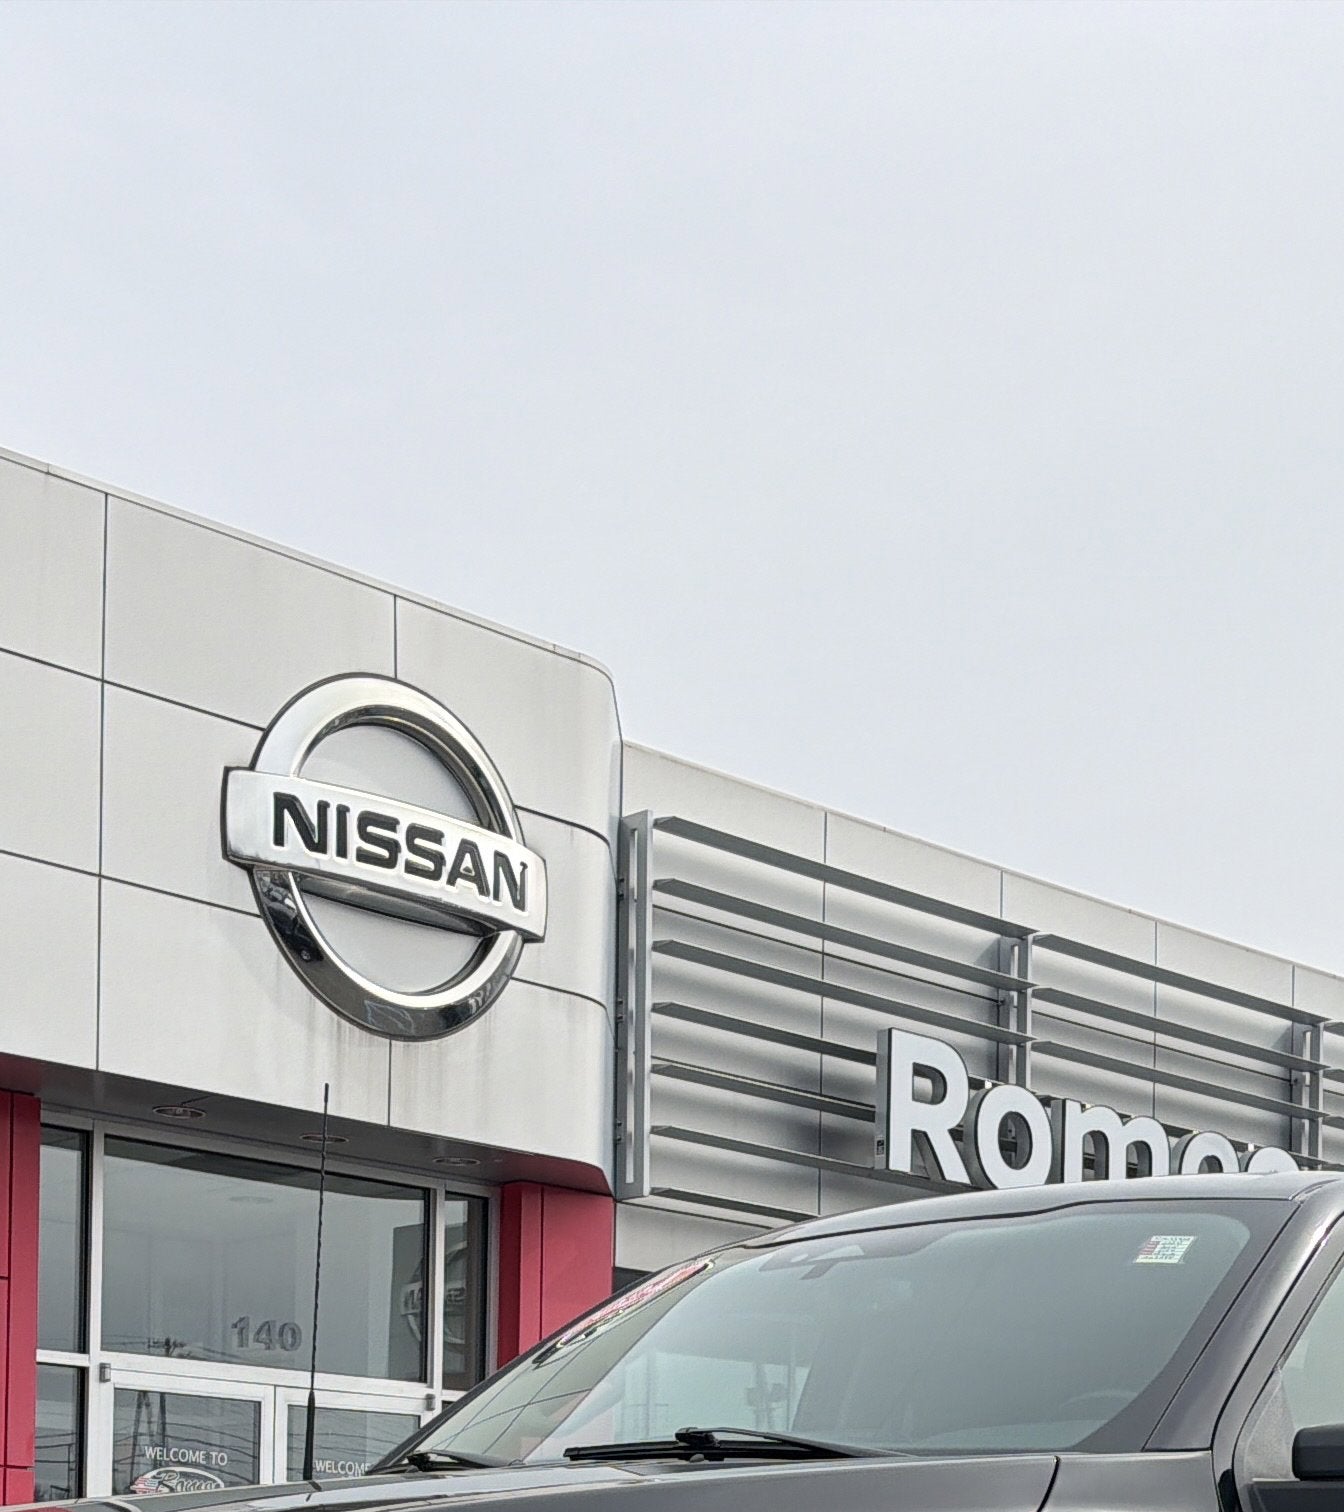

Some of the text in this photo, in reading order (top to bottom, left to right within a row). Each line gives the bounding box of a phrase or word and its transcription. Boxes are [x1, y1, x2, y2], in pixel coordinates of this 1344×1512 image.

[272, 791, 528, 912] NISSAN
[230, 1316, 302, 1352] 140
[145, 1446, 228, 1466] WELCOME TO
